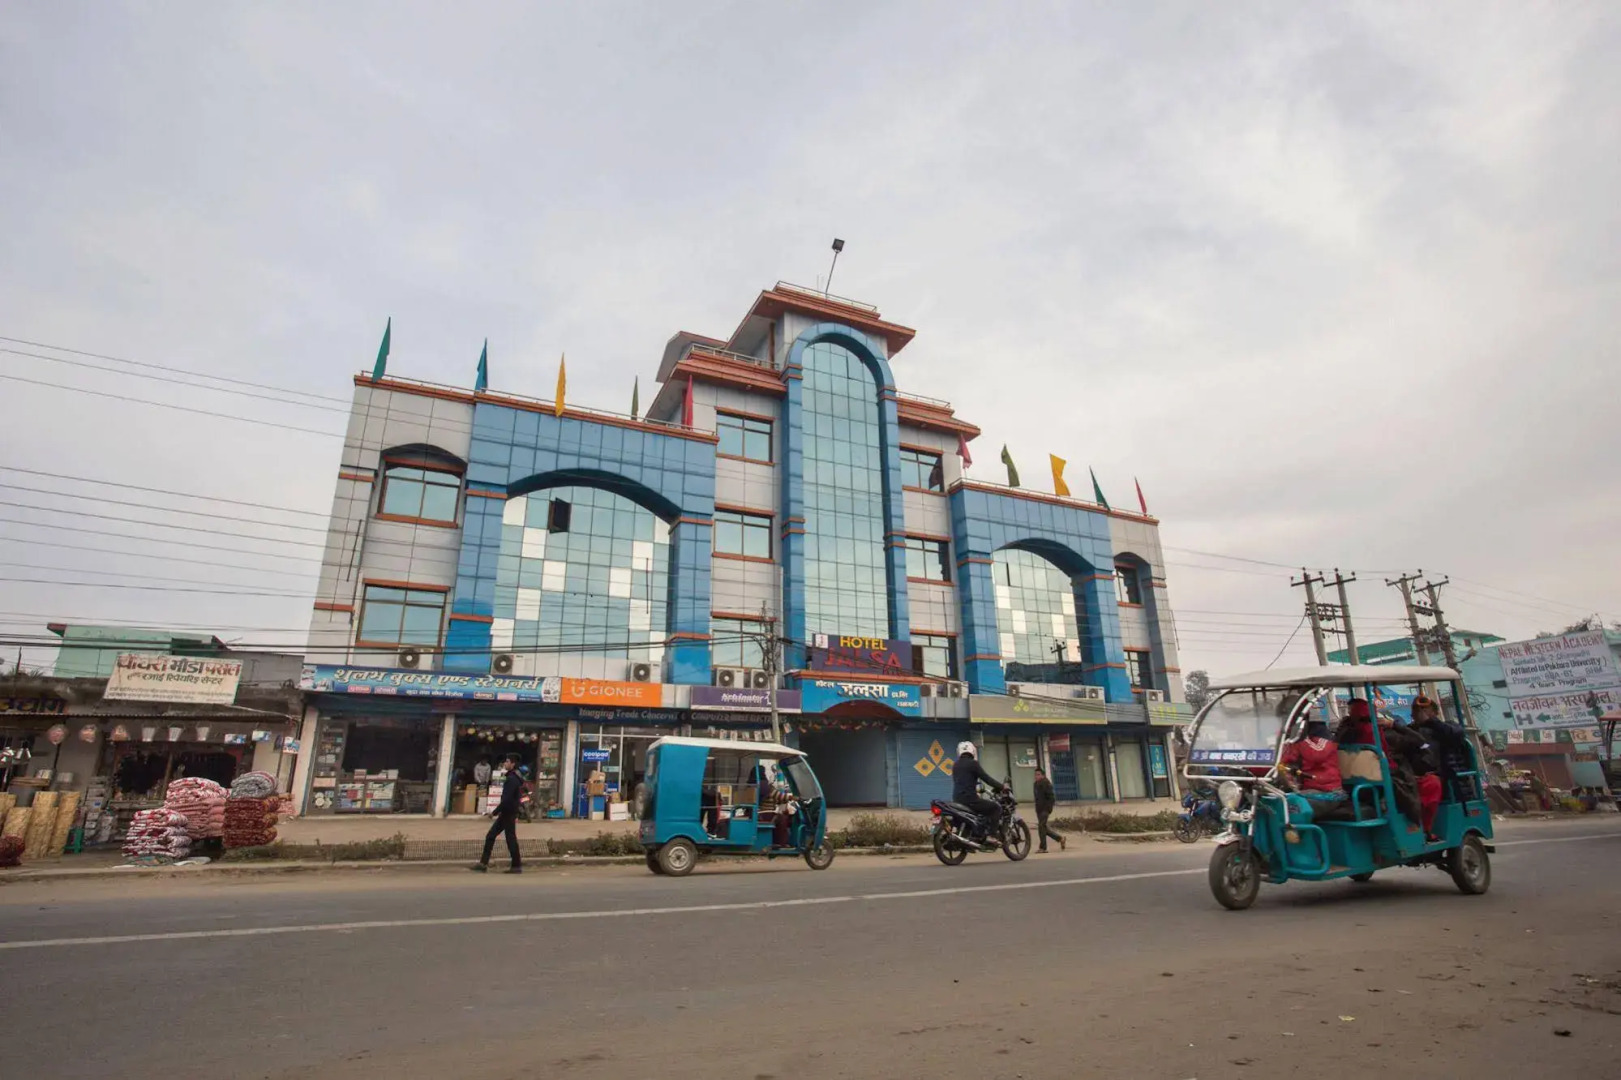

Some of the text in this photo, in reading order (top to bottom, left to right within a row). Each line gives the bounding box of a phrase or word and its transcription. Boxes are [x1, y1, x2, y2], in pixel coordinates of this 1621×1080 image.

[840, 635, 888, 650] HOTEL
[1498, 646, 1523, 658] NEPAL
[590, 685, 644, 698] GIONEE
[837, 682, 890, 699] जलसा
